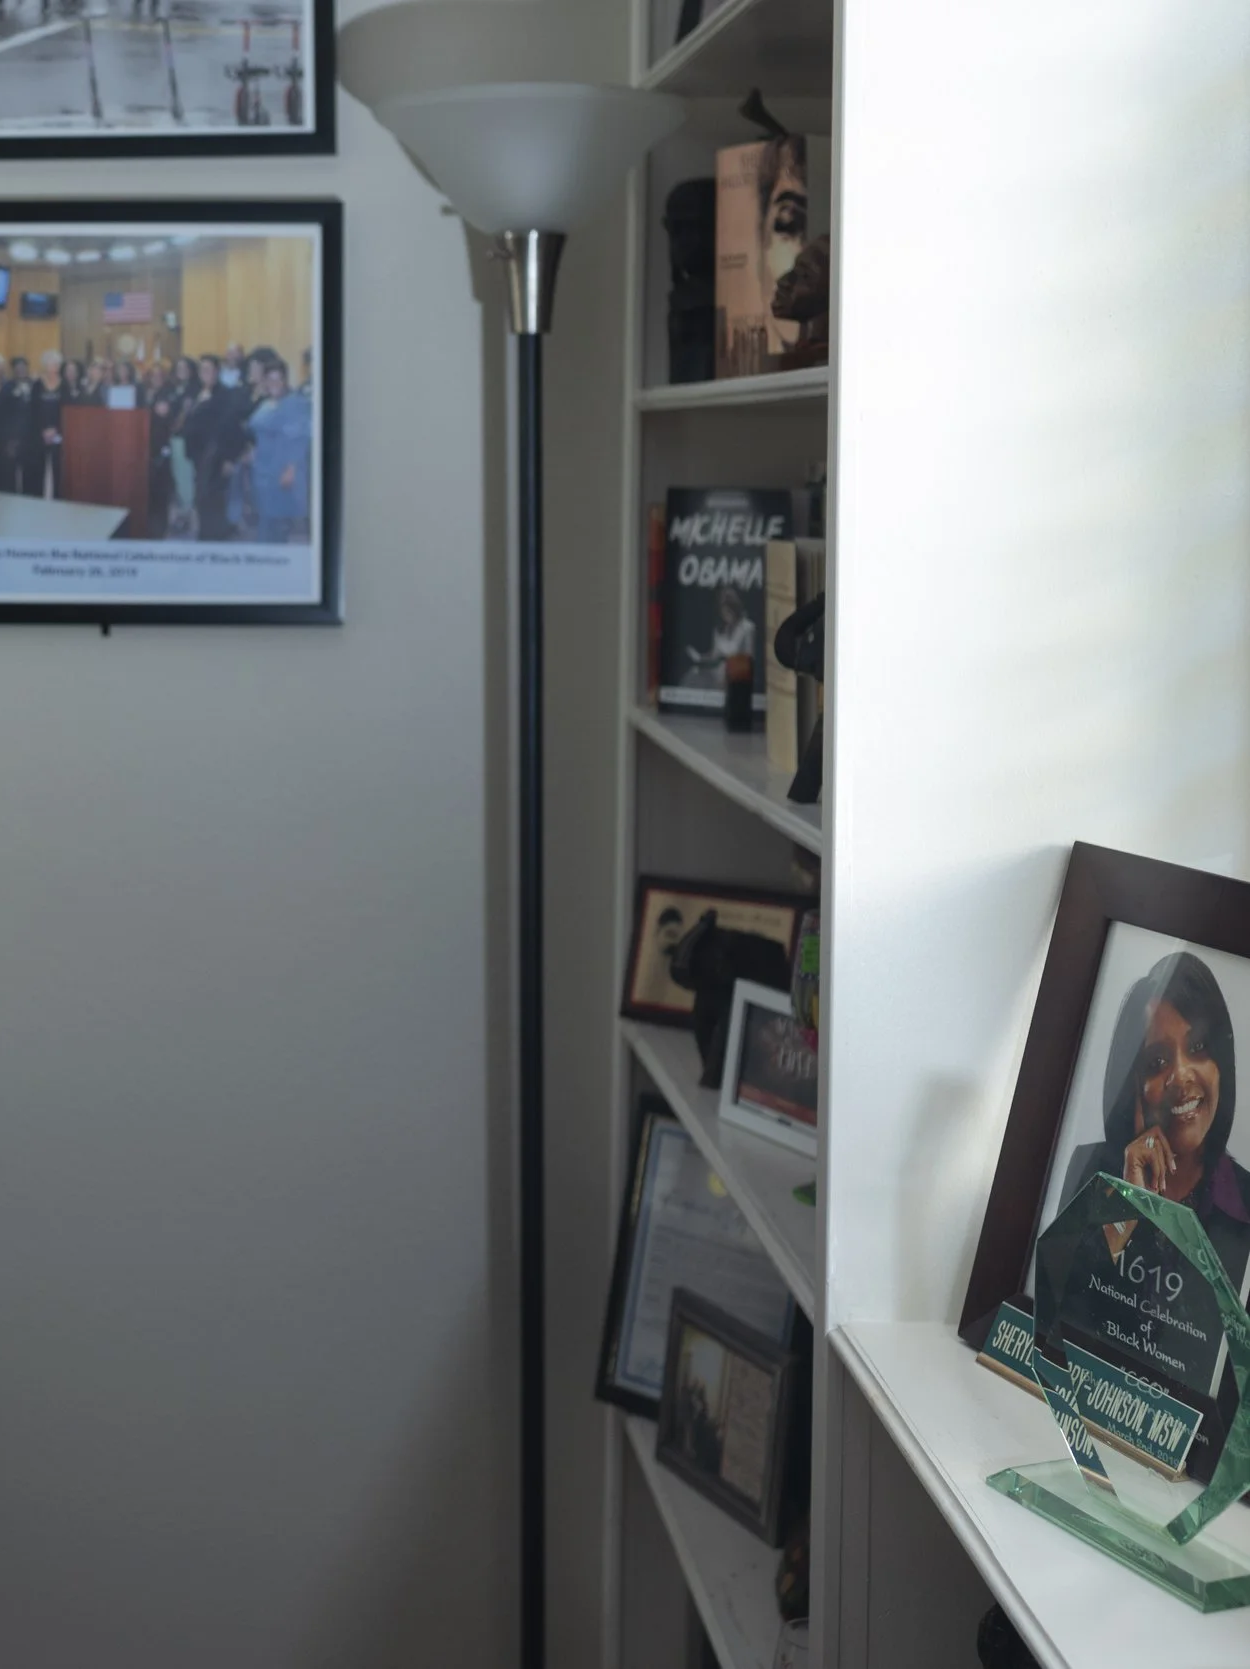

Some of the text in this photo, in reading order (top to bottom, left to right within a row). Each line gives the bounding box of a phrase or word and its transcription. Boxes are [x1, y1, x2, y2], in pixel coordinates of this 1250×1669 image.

[670, 513, 784, 548] MICHELLE
[679, 555, 763, 589] OBAMA
[1113, 1249, 1183, 1302] 1619
[1088, 1273, 1138, 1308] National
[1140, 1299, 1207, 1342] Celebration
[1106, 1320, 1186, 1372] Black Women
[1140, 1320, 1153, 1340] of
[992, 1319, 1034, 1367] SHERYL
[1147, 1409, 1187, 1453] MSW
[1157, 1450, 1180, 1469] 2019
